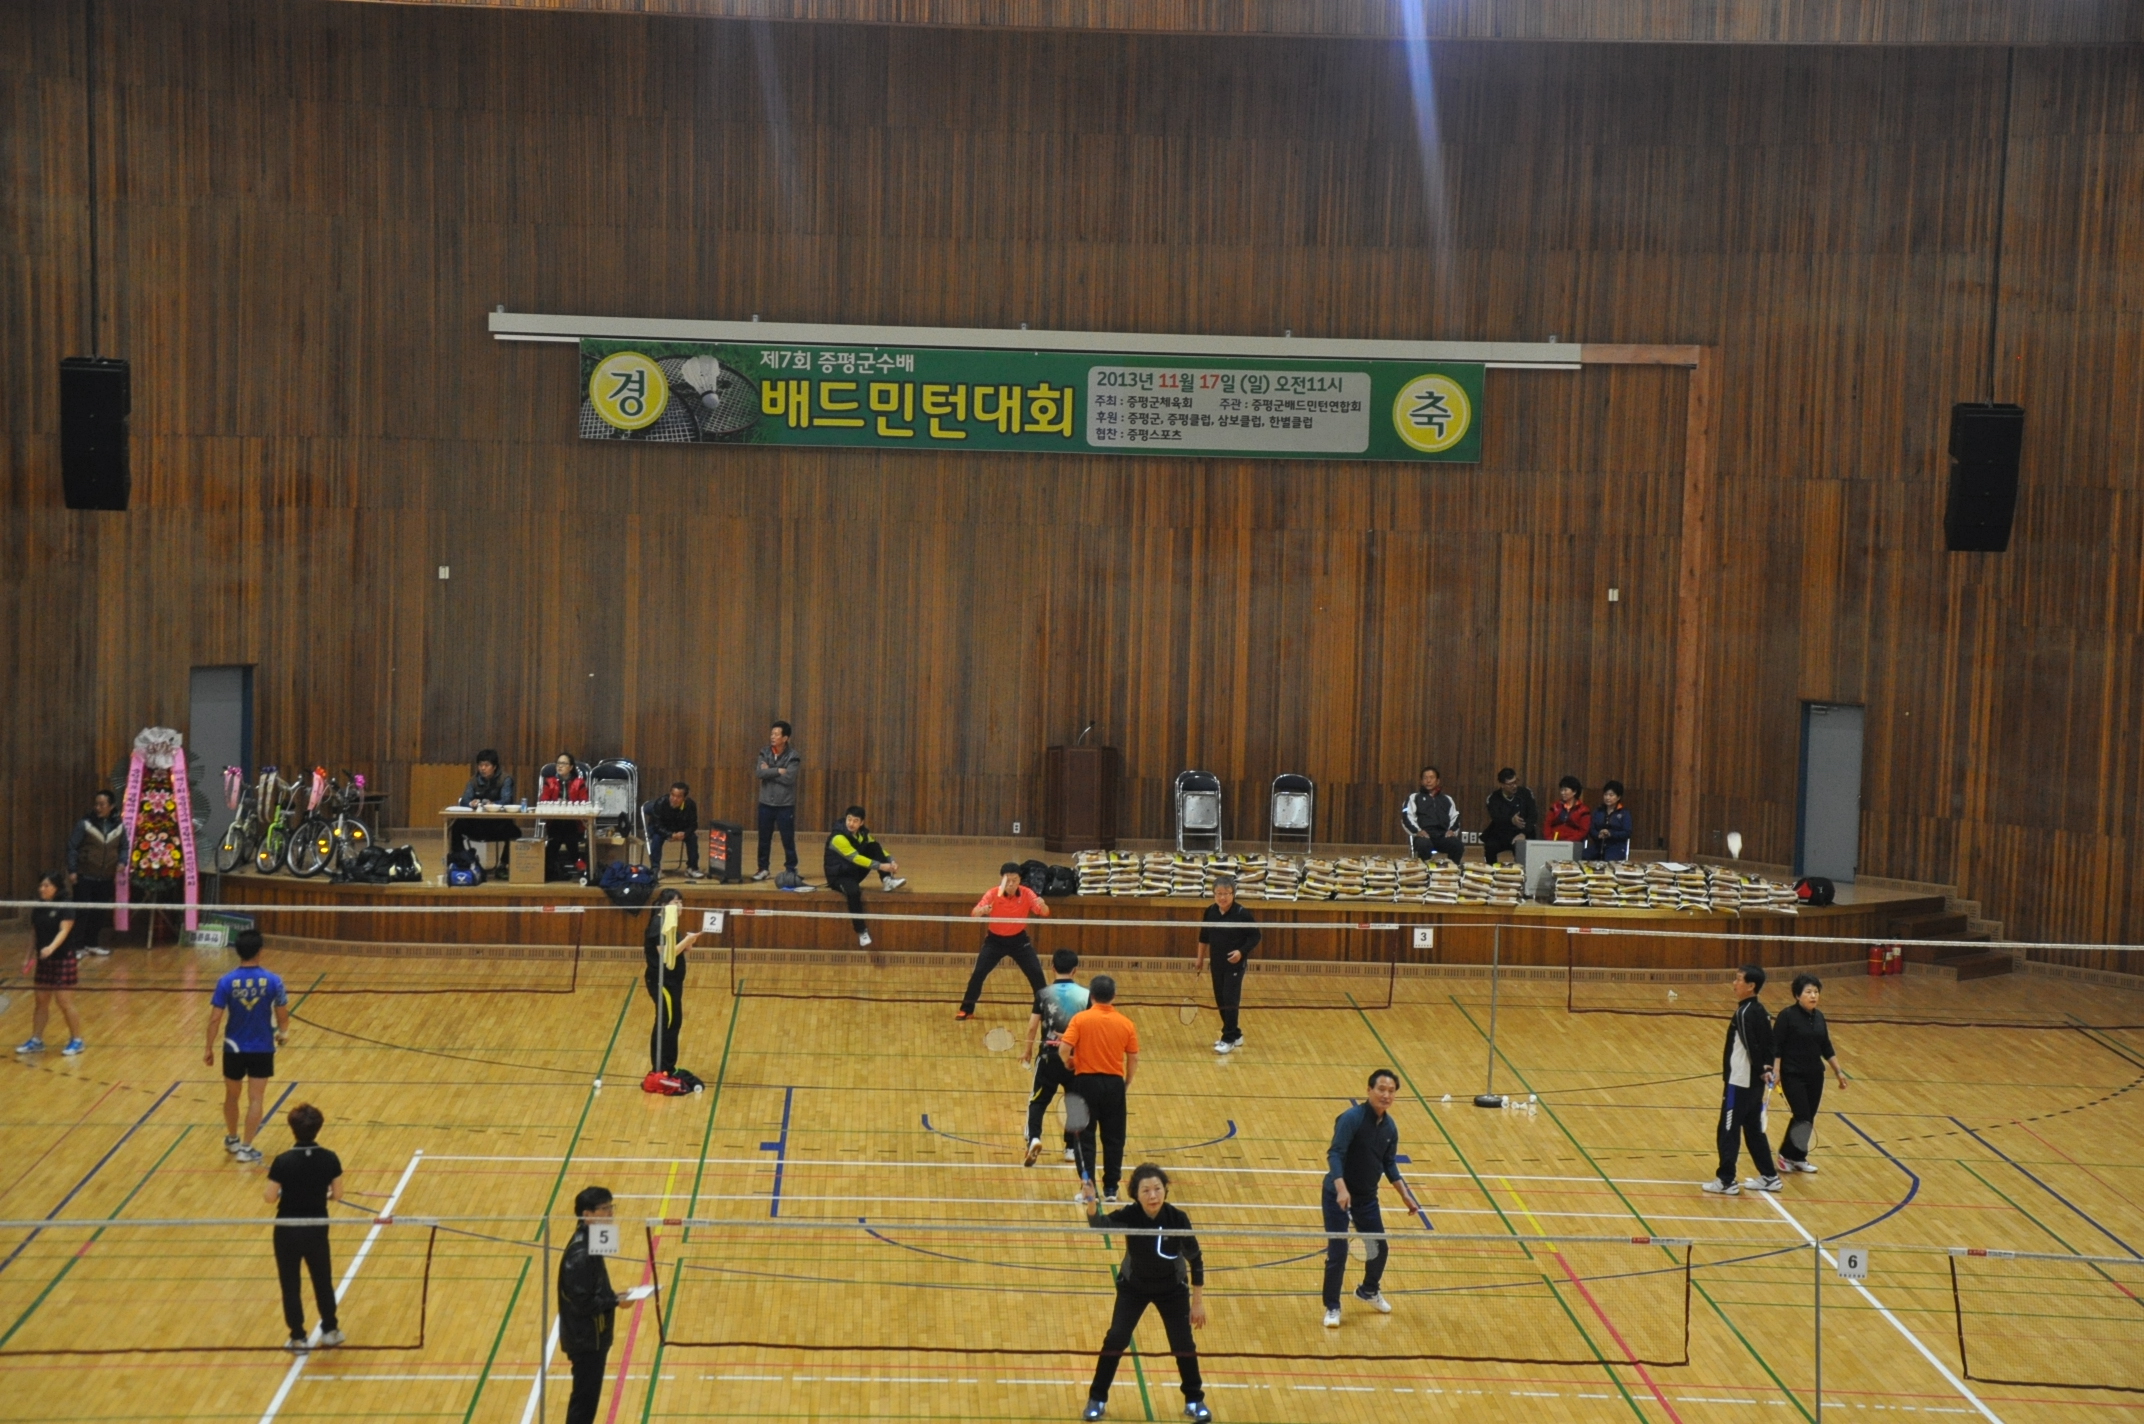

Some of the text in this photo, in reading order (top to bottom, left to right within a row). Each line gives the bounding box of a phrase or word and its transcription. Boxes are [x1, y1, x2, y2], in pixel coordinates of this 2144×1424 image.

[760, 350, 914, 374] 제7회 증평군수배
[1097, 371, 1342, 394] 2013년 11월 17일 (일) 오전11시
[608, 369, 645, 417] 경
[761, 379, 1074, 439] 배드민턴대회
[1095, 395, 1117, 407] 주최
[1127, 395, 1193, 409] 증평군체육회
[1219, 398, 1241, 411] 주관
[1251, 399, 1361, 413] 증평군배드민턴연합회
[1096, 411, 1117, 424] 후원
[1128, 412, 1164, 425] 증평군,
[1167, 413, 1215, 427] 증평클럽,
[1217, 414, 1265, 428] 삼보클럽,
[1269, 415, 1313, 429] 한별클럽
[1409, 390, 1452, 438] 축
[1095, 427, 1117, 440] 협찬
[1127, 428, 1182, 441] 증평스포츠
[709, 916, 717, 926] 2
[1420, 931, 1427, 942] 3
[599, 1230, 609, 1244] 5
[1847, 1254, 1858, 1269] 6
